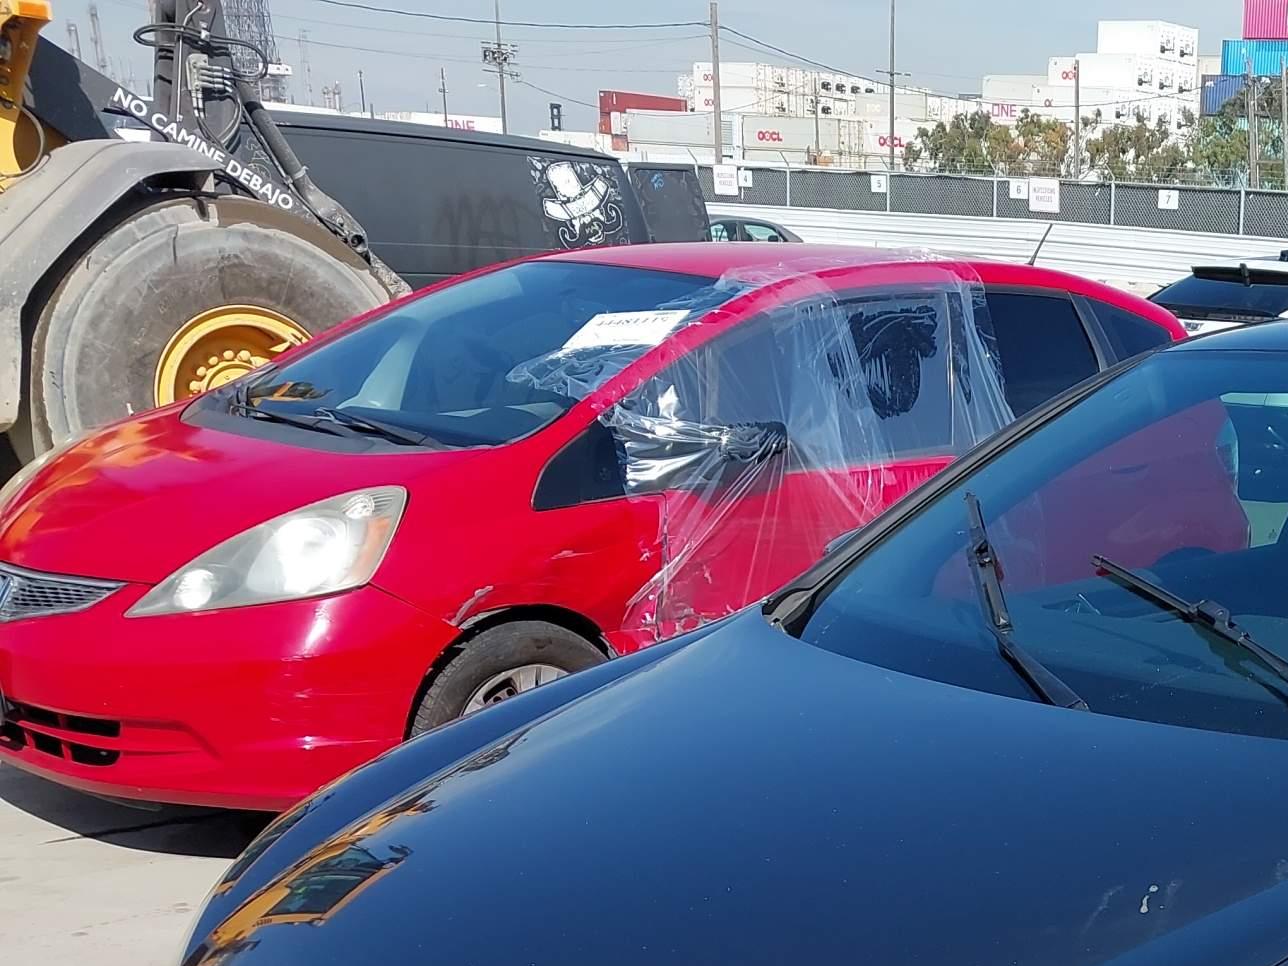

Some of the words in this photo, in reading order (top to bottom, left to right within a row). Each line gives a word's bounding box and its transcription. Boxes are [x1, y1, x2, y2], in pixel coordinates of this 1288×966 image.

[991, 103, 1017, 117] ONE
[112, 87, 148, 117] NO
[151, 113, 227, 165] CAMINE
[225, 159, 293, 210] DEBAJO
[1016, 184, 1022, 195] 6
[1165, 194, 1171, 205] 7
